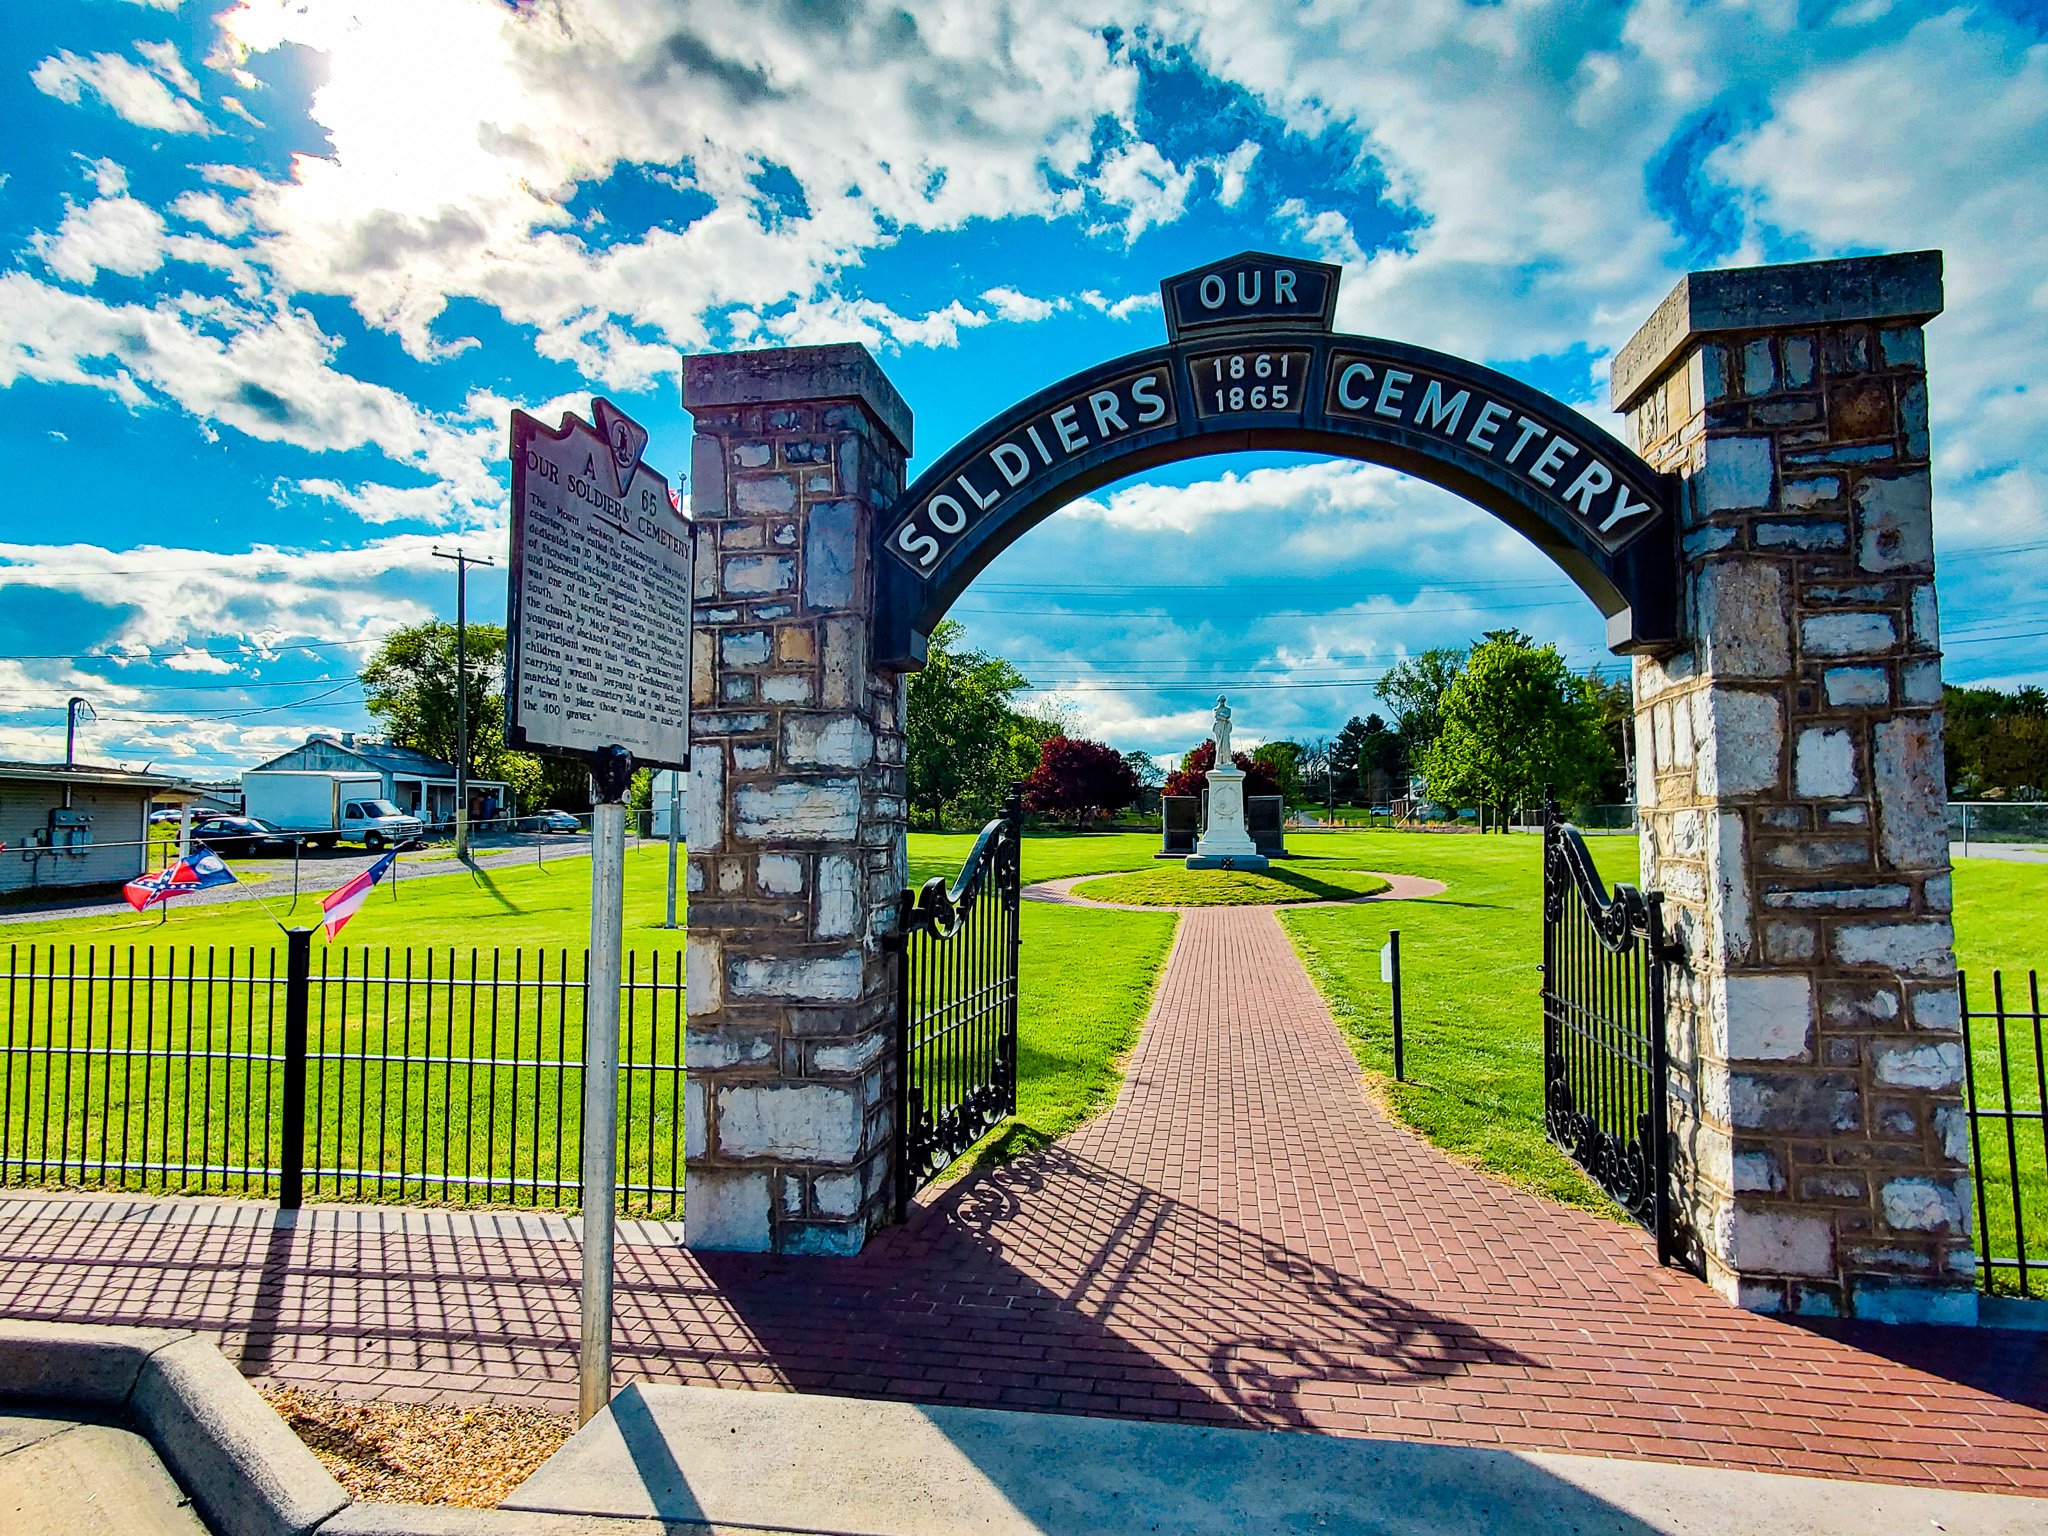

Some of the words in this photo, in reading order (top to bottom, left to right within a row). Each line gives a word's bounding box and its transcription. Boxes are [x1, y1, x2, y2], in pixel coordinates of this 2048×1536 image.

[1200, 270, 1297, 310] OUR
[1212, 354, 1289, 382] 1861
[1215, 385, 1290, 412] 1865
[583, 449, 596, 481] A
[1338, 363, 1651, 533] CEMETERY
[898, 376, 1166, 567] SOLDIERS
[527, 449, 558, 485] OUR
[567, 472, 632, 526] SOLDIERS'
[638, 515, 689, 560] CEMETERY
[530, 492, 546, 509] The
[556, 506, 578, 526] Mount
[587, 522, 613, 543] Jackson
[641, 487, 656, 518] 65
[529, 508, 567, 536] cemetery,
[571, 529, 583, 542] now
[587, 536, 607, 553] called
[610, 547, 621, 560] Our
[529, 522, 568, 549] dedicated
[572, 543, 580, 554] on
[584, 548, 591, 559] 10
[595, 552, 608, 569] May
[629, 570, 638, 582] the
[527, 566, 542, 580] was
[548, 575, 561, 588] one
[567, 581, 574, 593] of
[579, 586, 590, 599] the
[594, 592, 607, 606] first
[611, 601, 625, 613] such
[528, 535, 537, 549] of
[542, 542, 578, 567] Stonewall
[584, 561, 615, 583] Jackson's
[643, 588, 655, 601] The
[528, 550, 542, 566] and
[546, 558, 586, 584] Decoration
[639, 599, 646, 611] by
[647, 603, 656, 614] the
[658, 607, 670, 620] local
[527, 580, 552, 599] South.
[563, 593, 576, 608] The
[580, 600, 605, 618] service
[609, 612, 628, 629] began
[632, 621, 644, 633] with
[647, 629, 654, 637] an
[527, 595, 540, 609] the
[545, 601, 572, 620] church
[576, 613, 584, 626] by
[589, 617, 609, 635] Major
[612, 626, 632, 642] Henry
[675, 650, 683, 659] the
[527, 610, 563, 633] youngest
[567, 623, 574, 634] of
[577, 626, 608, 645] Jackson's
[612, 639, 625, 651] staff
[525, 626, 530, 635] a
[535, 627, 578, 651] participant
[582, 643, 601, 656] wrote
[605, 649, 617, 661] that
[526, 639, 560, 658] children
[565, 654, 572, 662] as
[577, 655, 591, 667] well
[594, 661, 602, 670] as
[607, 665, 622, 677] many
[524, 669, 559, 686] marched
[564, 680, 571, 689] to
[576, 682, 587, 693] the
[592, 686, 623, 702] cemetery
[625, 693, 635, 705] 3/4
[639, 698, 645, 707] of
[525, 654, 562, 675] carrying
[568, 666, 597, 682] wreaths
[603, 676, 632, 693] prepared
[637, 685, 646, 695] the
[650, 690, 660, 700] day
[524, 683, 532, 695] of
[539, 688, 557, 700] town
[563, 693, 570, 702] to
[576, 696, 594, 709] place
[599, 701, 617, 713] those
[622, 706, 645, 719] wreaths
[650, 714, 656, 722] on
[677, 719, 682, 727] of
[524, 698, 537, 710] the
[543, 702, 559, 715] 400
